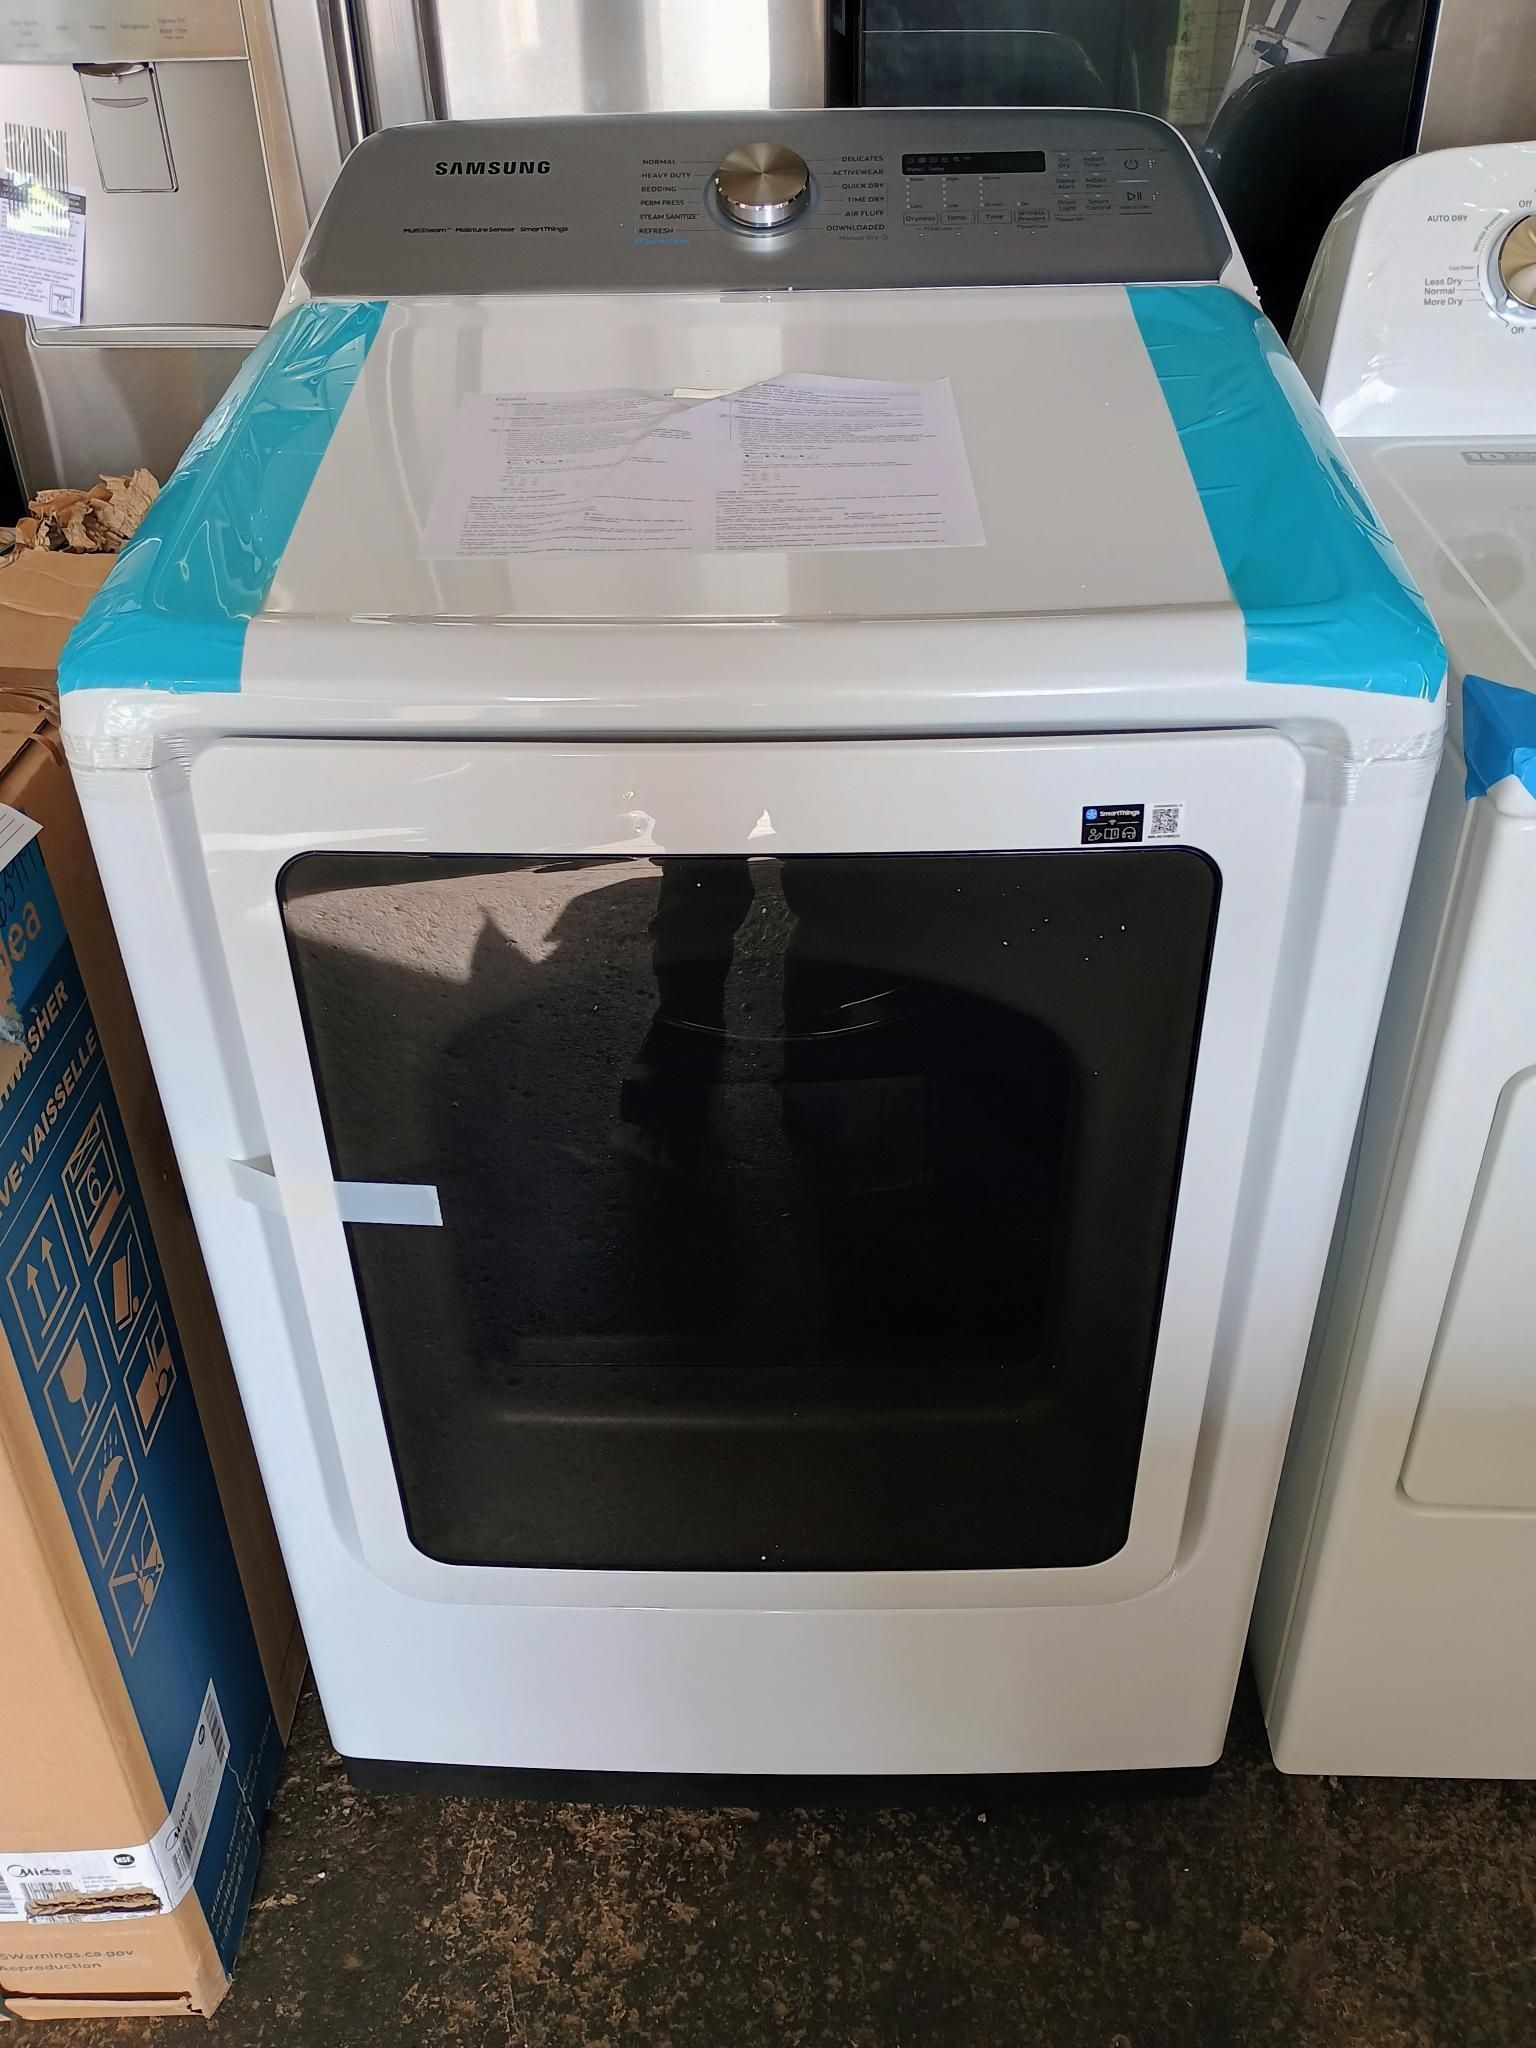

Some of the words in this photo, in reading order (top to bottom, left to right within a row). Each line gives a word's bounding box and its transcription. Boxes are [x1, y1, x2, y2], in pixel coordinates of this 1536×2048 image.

[434, 160, 551, 176] SAMSUNG
[1518, 199, 1533, 208] Off
[906, 215, 935, 223] Dryness
[1451, 214, 1468, 222] DRY
[1424, 277, 1445, 286] Less
[1446, 277, 1462, 287] Dry
[1424, 287, 1456, 295] Normal
[1423, 298, 1446, 306] More
[1447, 298, 1463, 307] Dry
[1511, 325, 1525, 335] Off
[0, 1026, 98, 1218] VE-VAISSELLE
[14, 1866, 73, 1877] Midea
